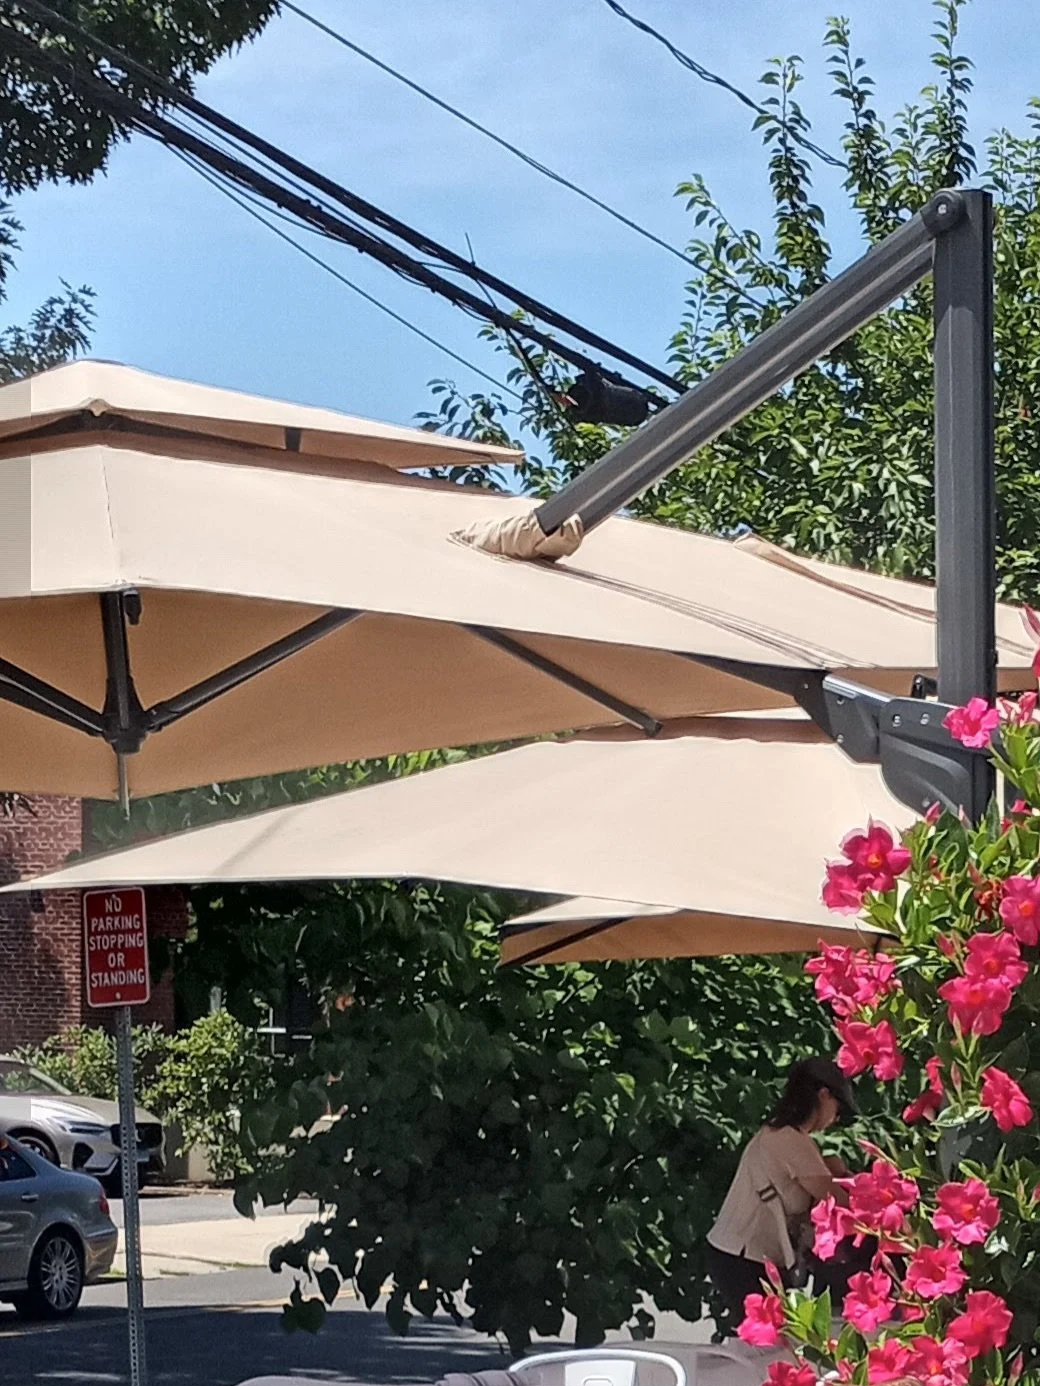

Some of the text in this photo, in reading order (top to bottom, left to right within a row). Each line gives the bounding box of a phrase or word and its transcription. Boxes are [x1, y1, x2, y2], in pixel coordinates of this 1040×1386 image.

[105, 897, 122, 912] NO
[91, 915, 140, 931] PARKING
[89, 933, 143, 950] STOPPING
[108, 953, 125, 967] OR
[91, 969, 144, 987] STANDING
